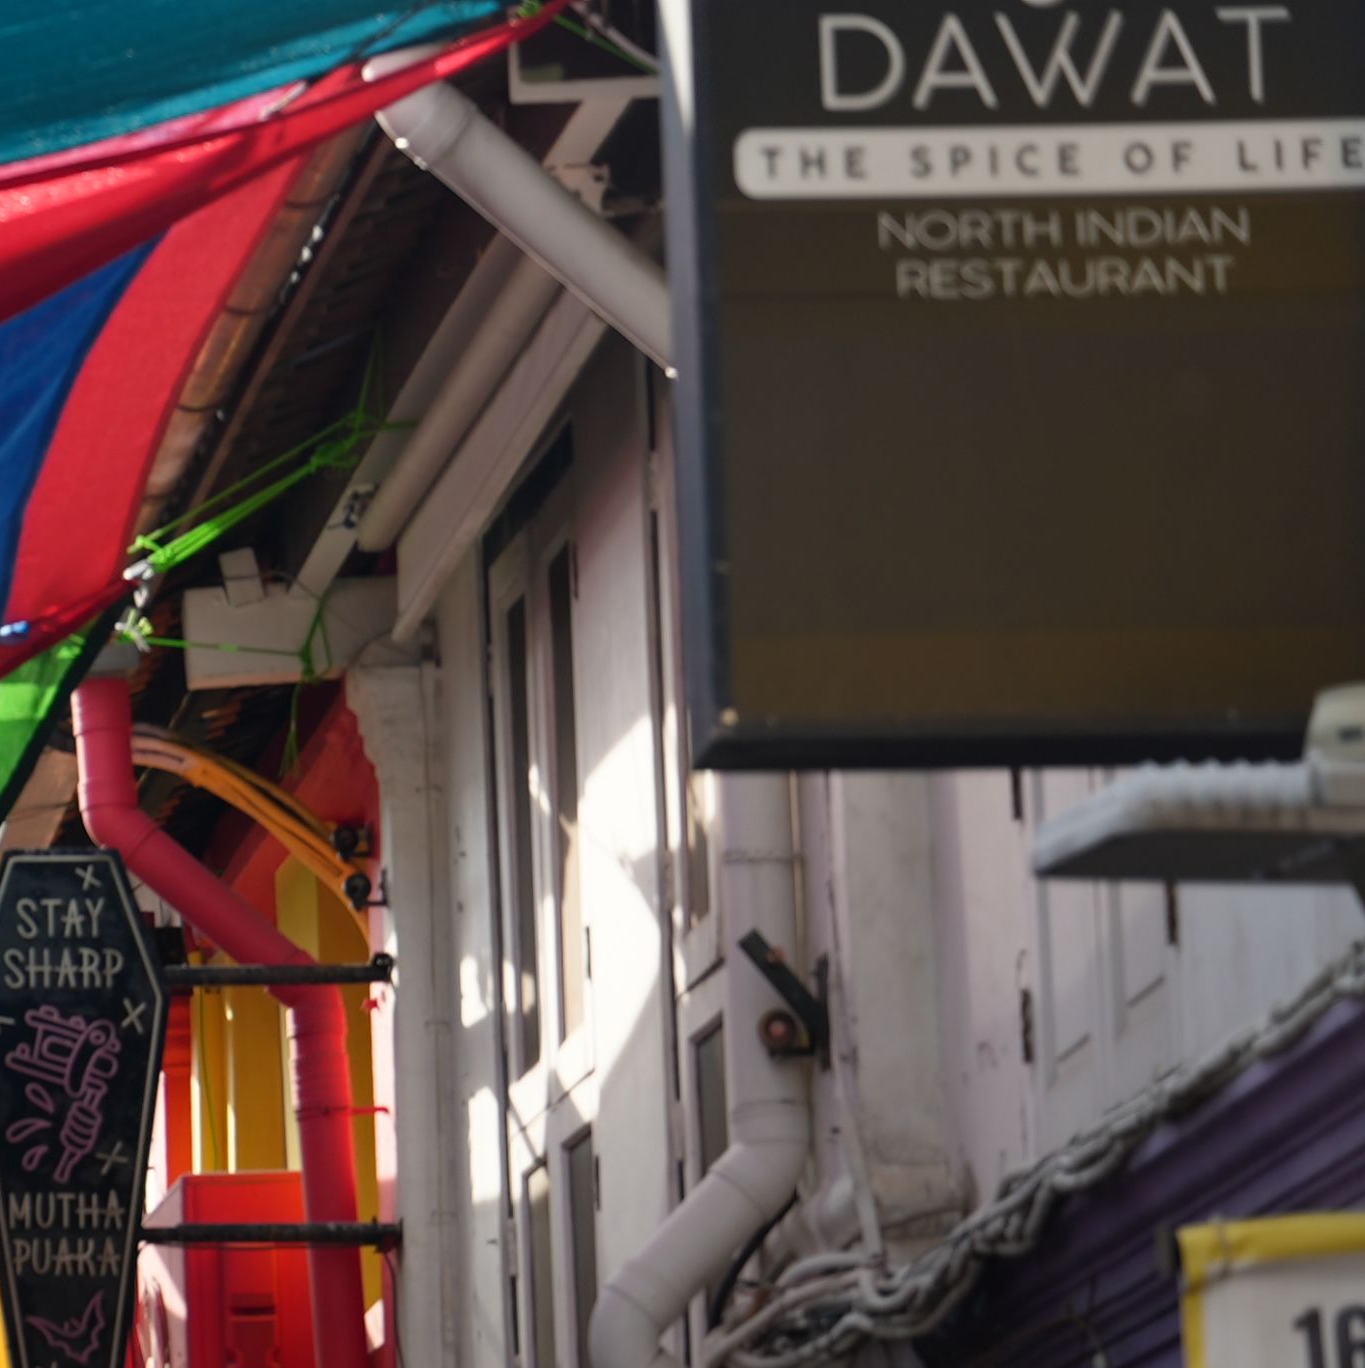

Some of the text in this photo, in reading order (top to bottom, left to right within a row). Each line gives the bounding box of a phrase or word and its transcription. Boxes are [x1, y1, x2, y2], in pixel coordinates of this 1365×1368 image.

[818, 7, 1291, 112] DAWAT
[759, 135, 1365, 181] THE SPICE OF LIFE
[877, 205, 1252, 251] NORTH INDIAN
[895, 254, 1235, 299] RESTAURANT
[15, 898, 106, 941] STAY
[3, 946, 124, 990] SHARP
[8, 1191, 126, 1231] MUTHA
[14, 1238, 121, 1278] PUAKA
